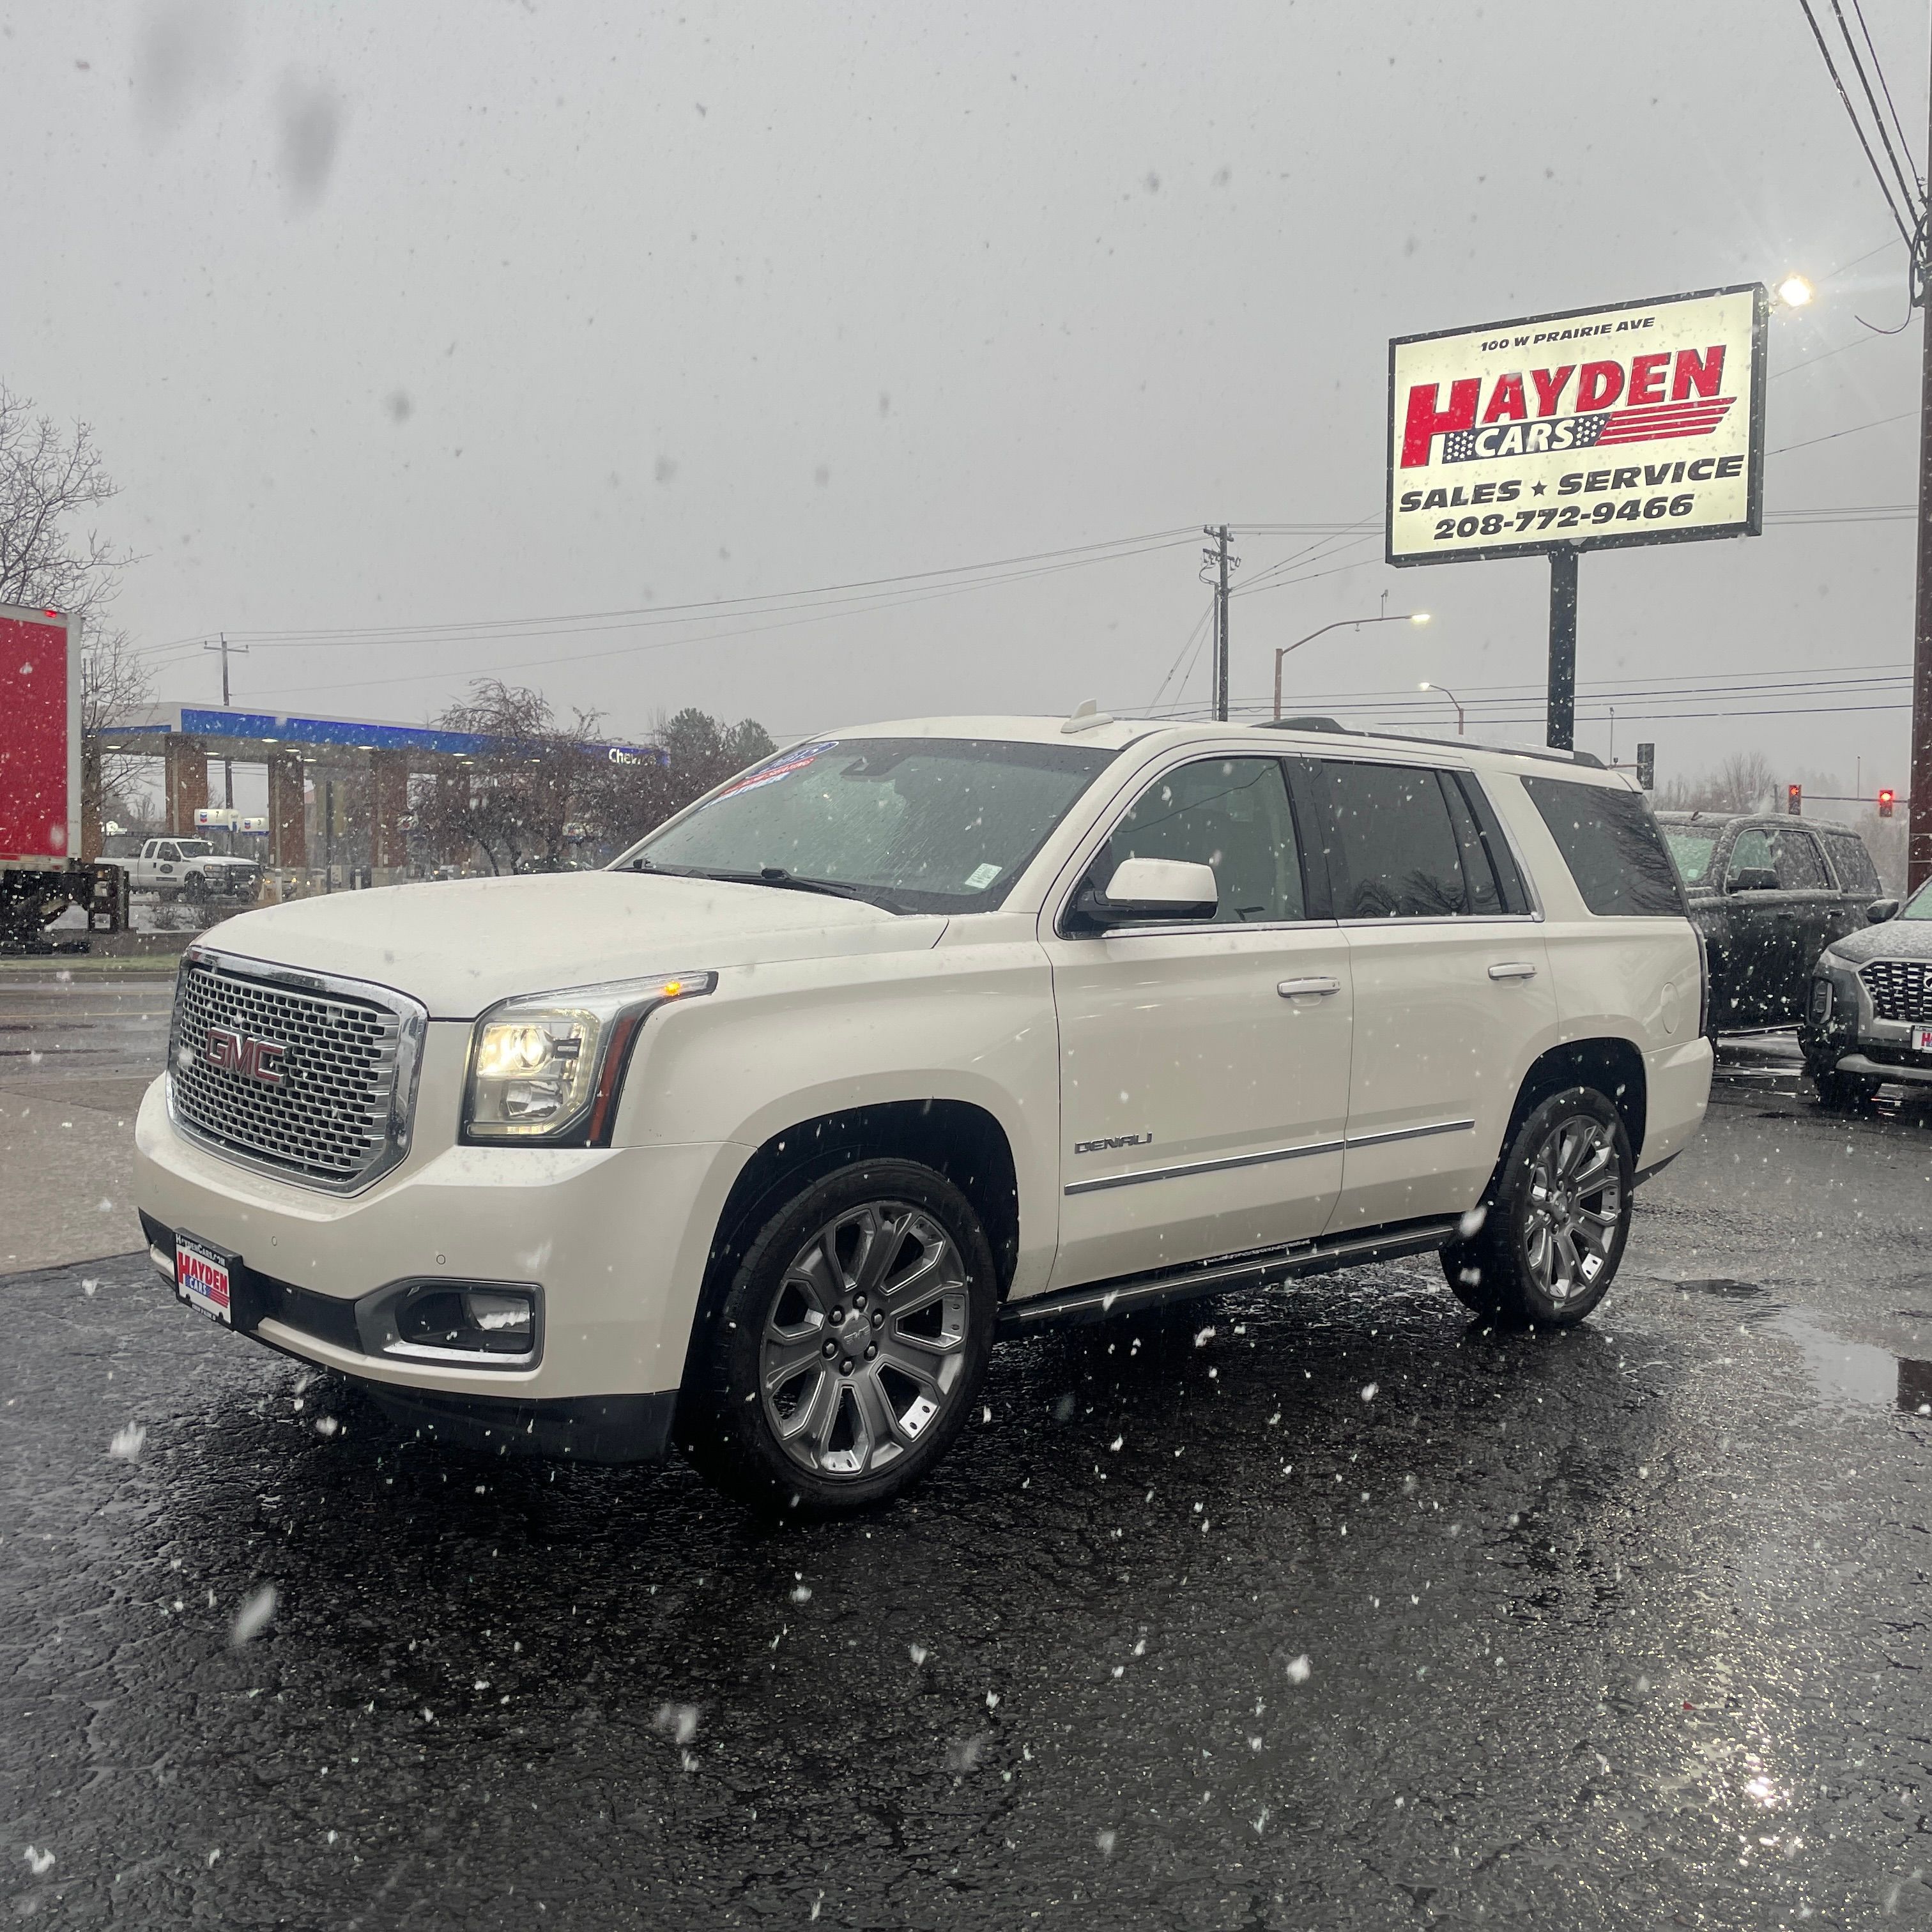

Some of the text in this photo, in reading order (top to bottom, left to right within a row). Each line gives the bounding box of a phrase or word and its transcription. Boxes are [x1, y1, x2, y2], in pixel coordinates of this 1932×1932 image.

[1481, 317, 1655, 351] 100 W PRAIRIE AVE
[1400, 344, 1727, 469] HAYDEN
[1475, 419, 1575, 457] CARS
[1399, 455, 1744, 512] SALES SERVICE
[1434, 494, 1694, 540] 208-772-9466
[206, 1026, 287, 1086] GMC
[1075, 1131, 1152, 1154] DENALI
[178, 1250, 228, 1294] HAYDEN
[189, 1278, 207, 1295] CARS
